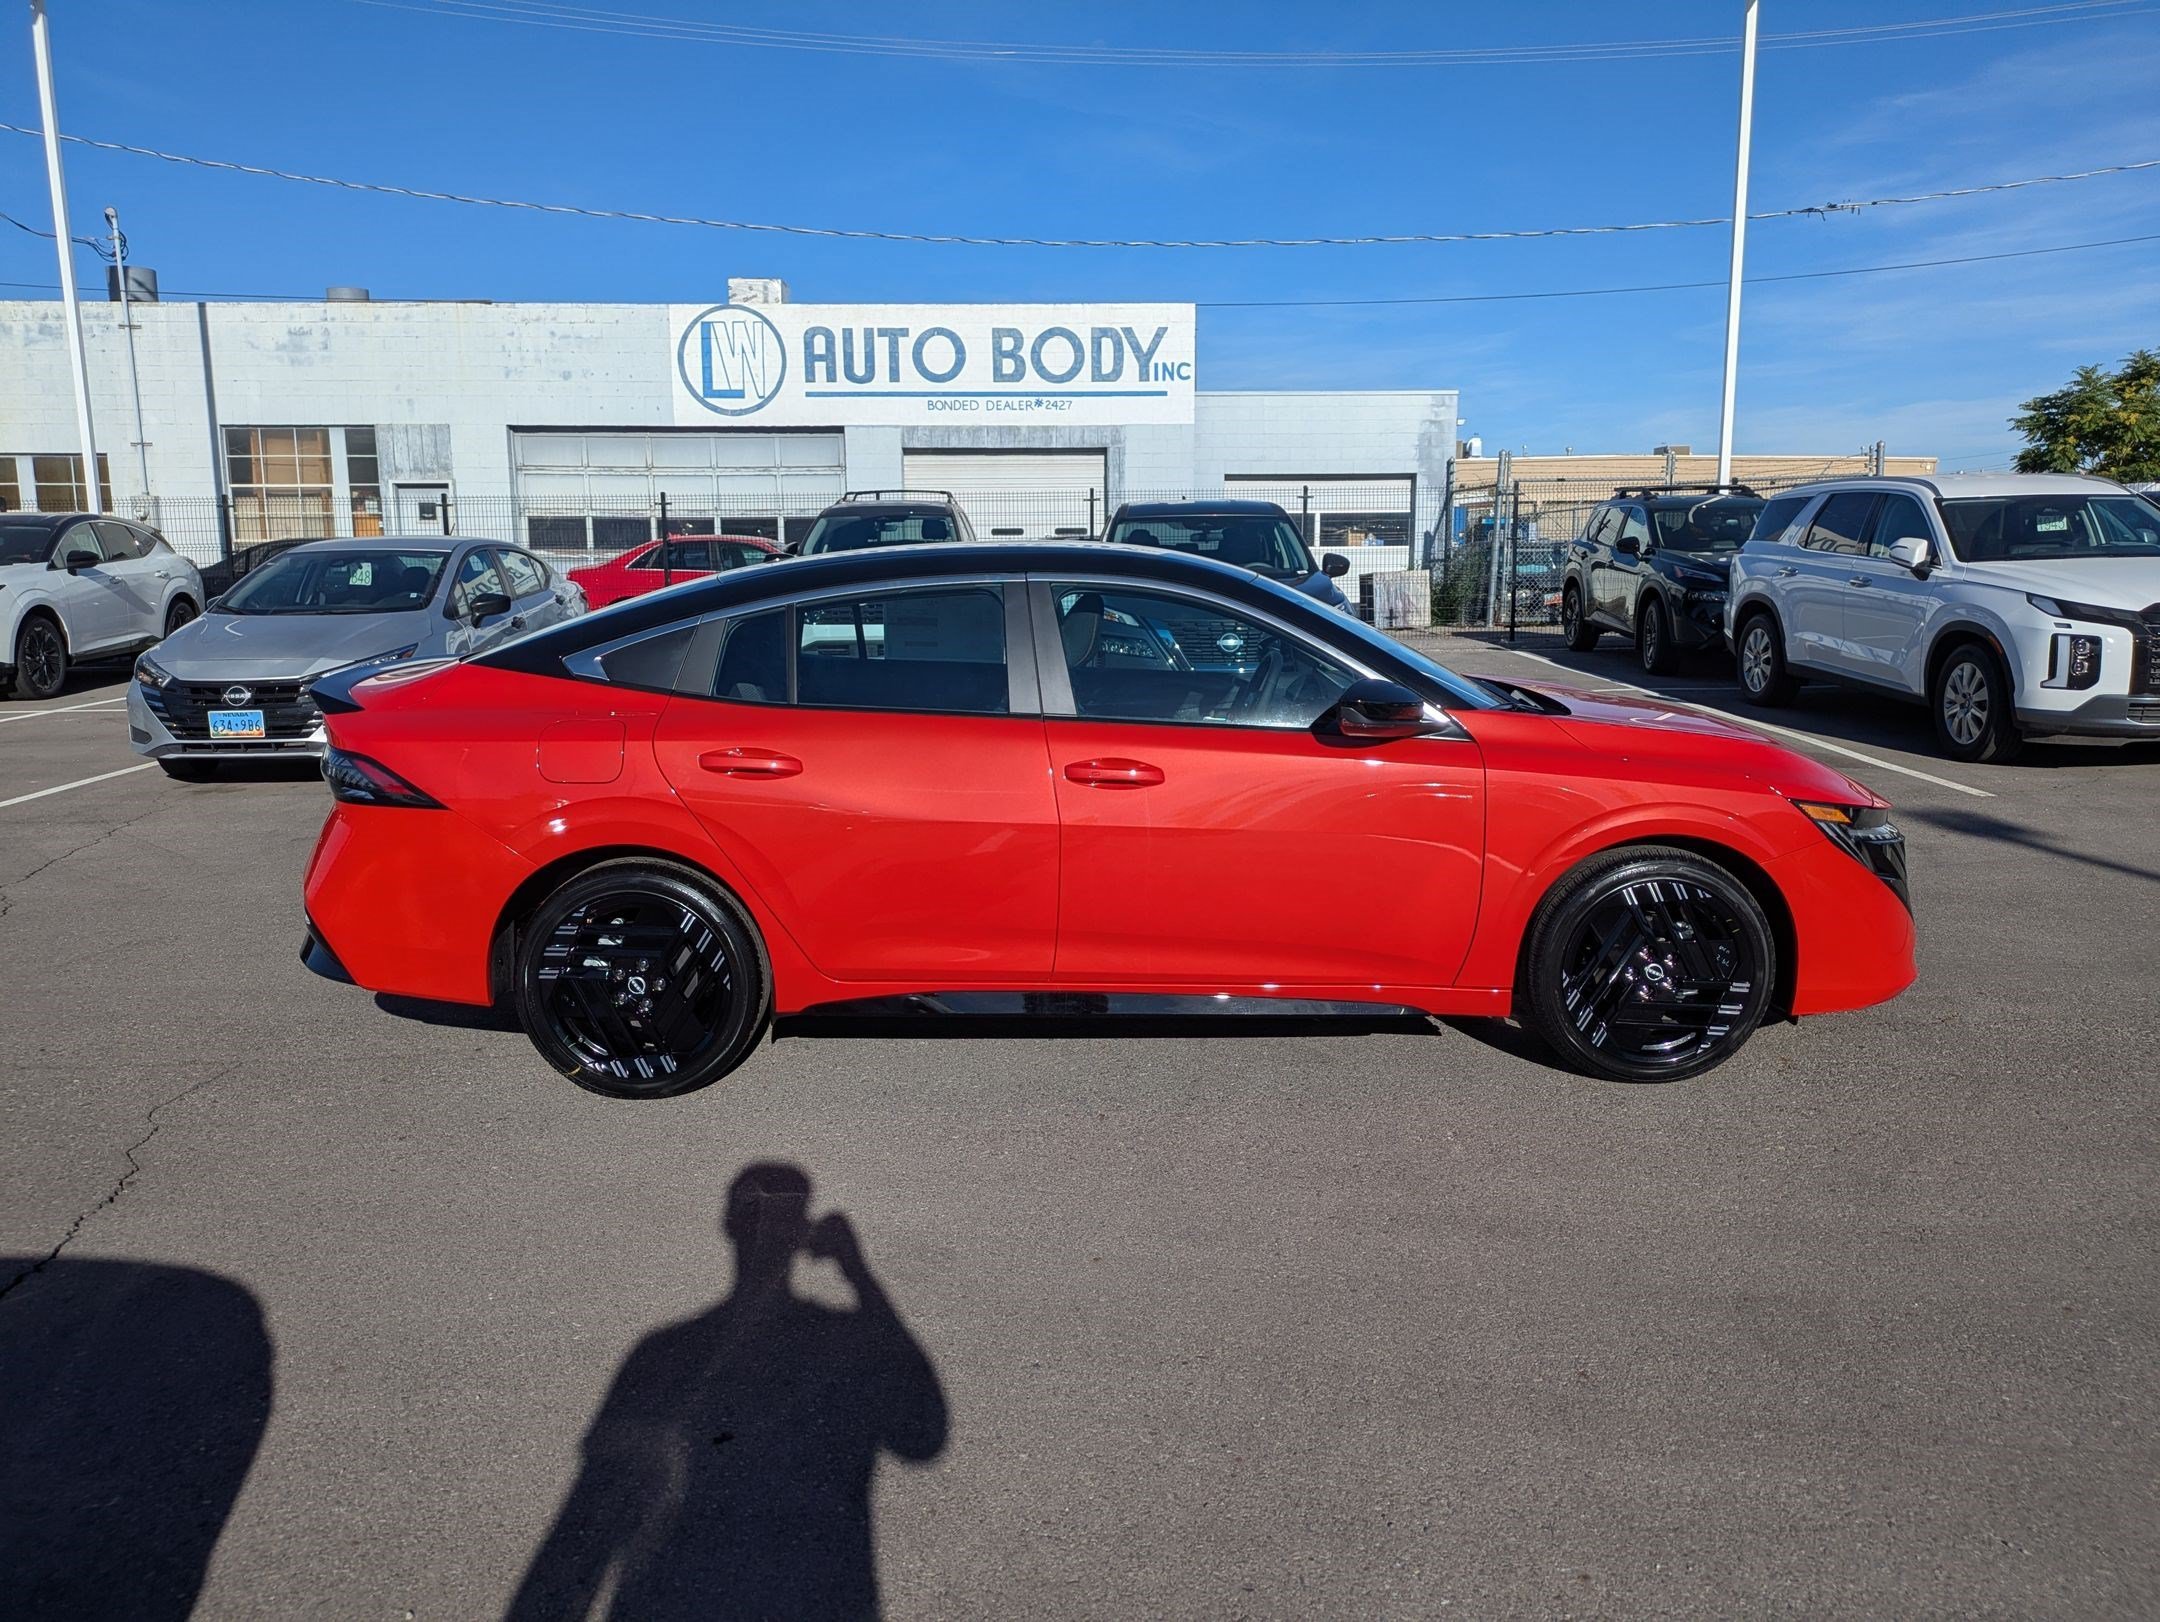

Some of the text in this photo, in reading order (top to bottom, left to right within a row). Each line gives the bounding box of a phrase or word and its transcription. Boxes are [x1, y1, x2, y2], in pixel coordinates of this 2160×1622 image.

[803, 326, 1192, 384] AUTO BODY INC
[927, 400, 980, 411] BONDED
